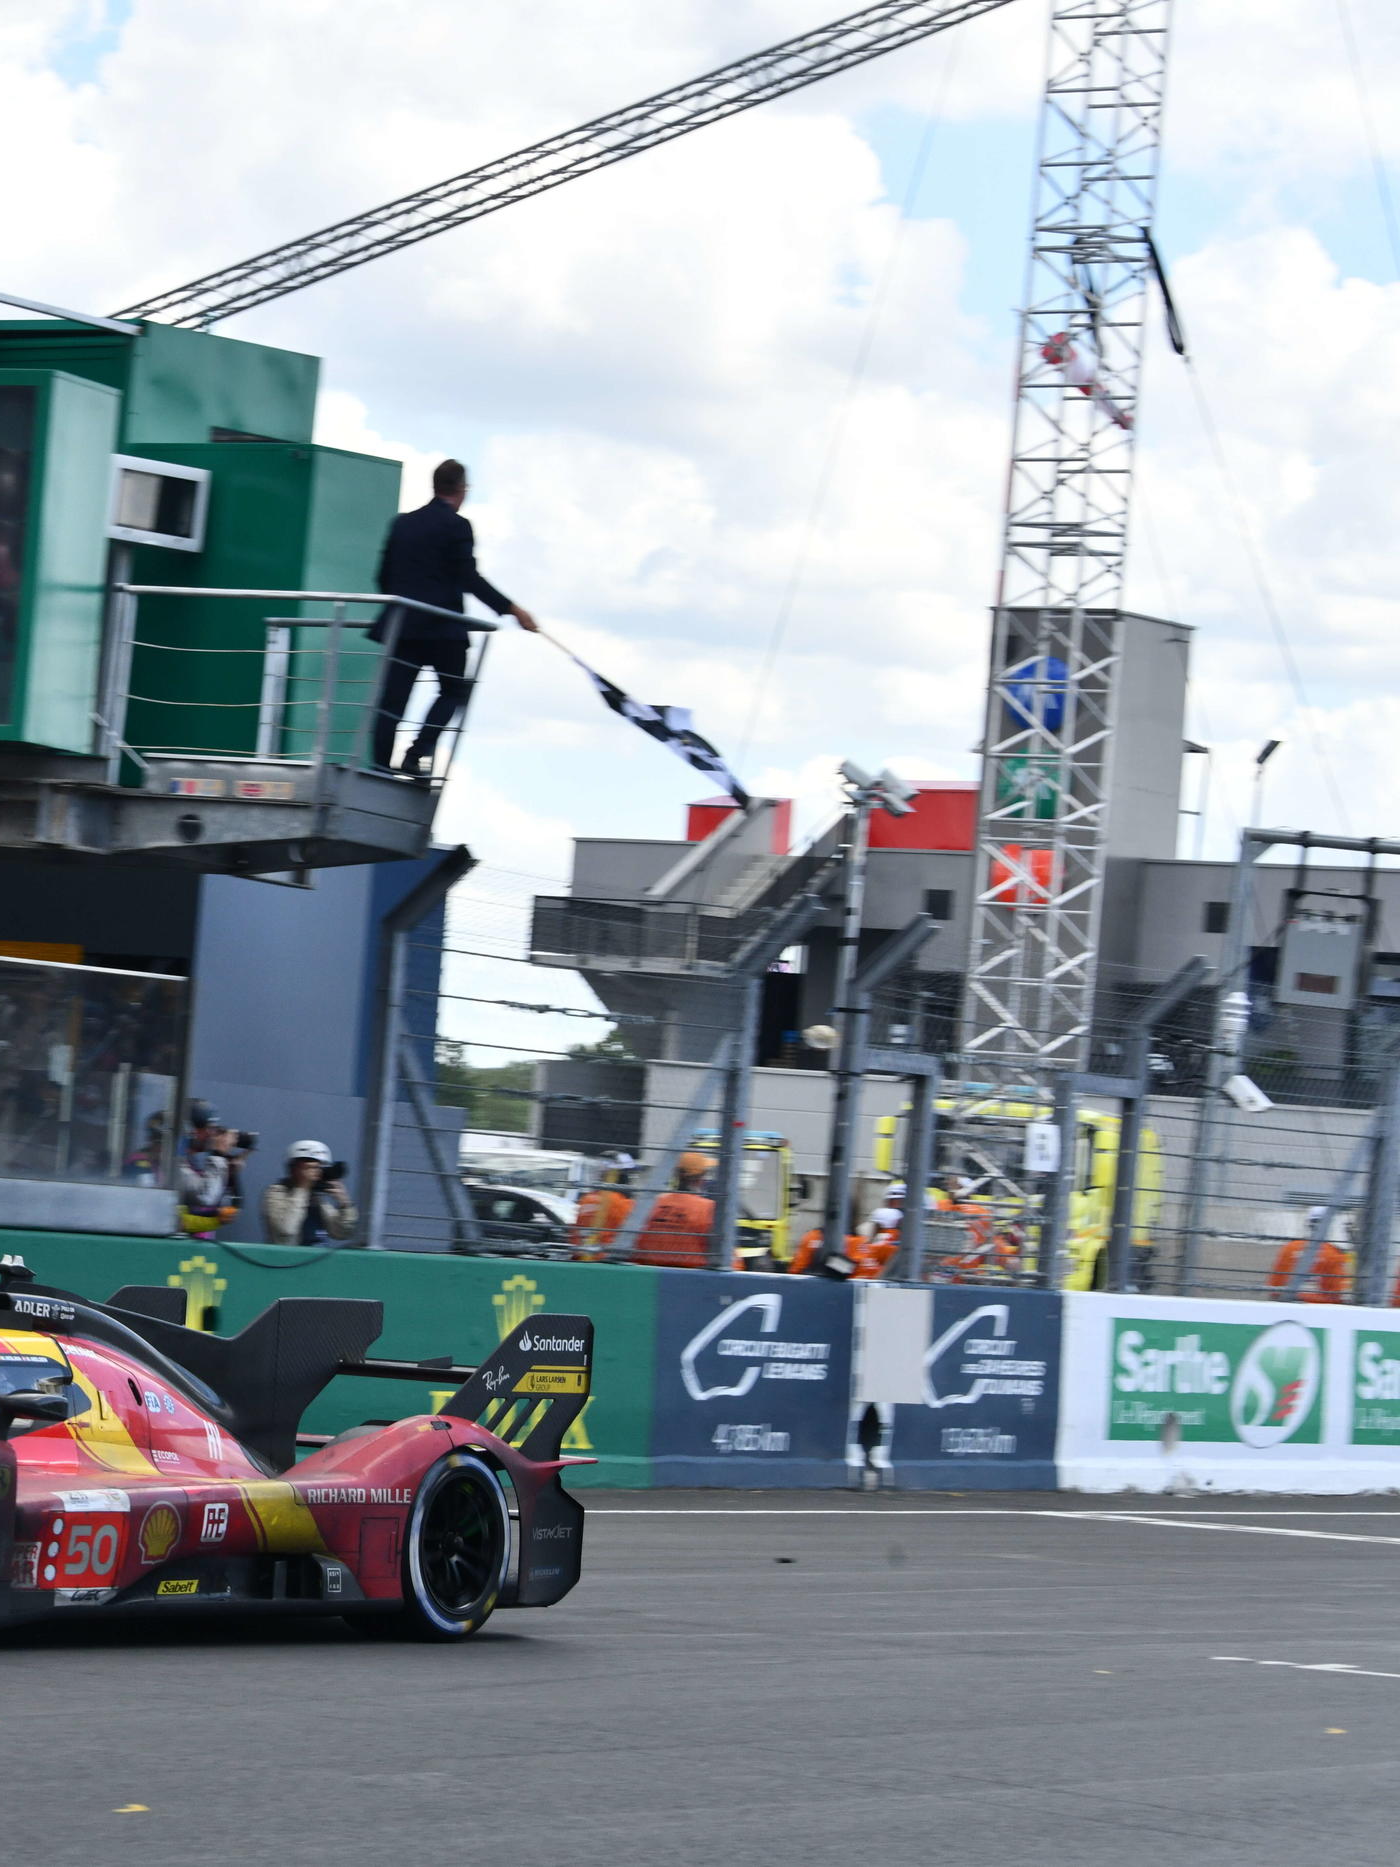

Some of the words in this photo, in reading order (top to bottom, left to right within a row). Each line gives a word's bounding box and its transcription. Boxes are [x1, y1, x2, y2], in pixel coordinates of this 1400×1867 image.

[15, 1300, 50, 1318] ADLER
[533, 1335, 585, 1352] Santander
[1115, 1330, 1230, 1395] Sarthe
[307, 1487, 366, 1504] RICHARD
[370, 1488, 411, 1504] MILLE
[64, 1524, 119, 1576] 50
[161, 1581, 194, 1594] Sabelt
